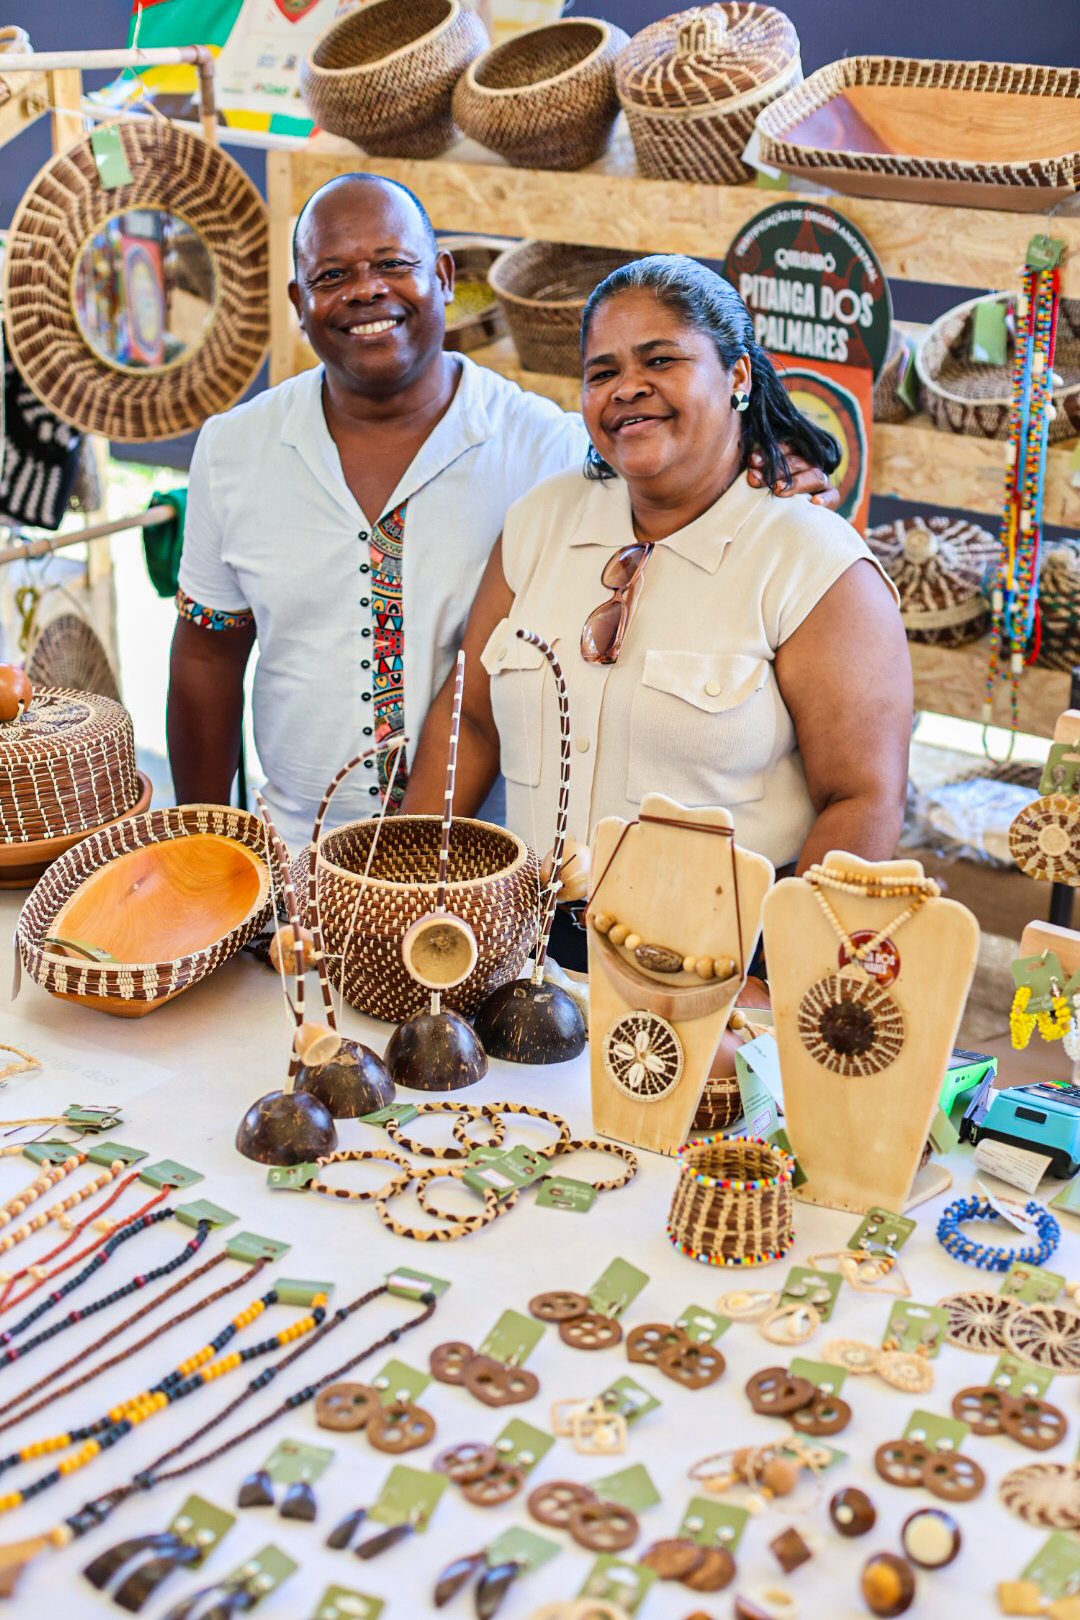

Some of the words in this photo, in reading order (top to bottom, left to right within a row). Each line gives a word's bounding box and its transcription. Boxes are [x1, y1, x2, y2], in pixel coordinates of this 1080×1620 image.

[791, 208, 804, 221] DE
[739, 273, 816, 317] PITANGA
[820, 285, 874, 327] DOS
[754, 313, 849, 362] PALMARES
